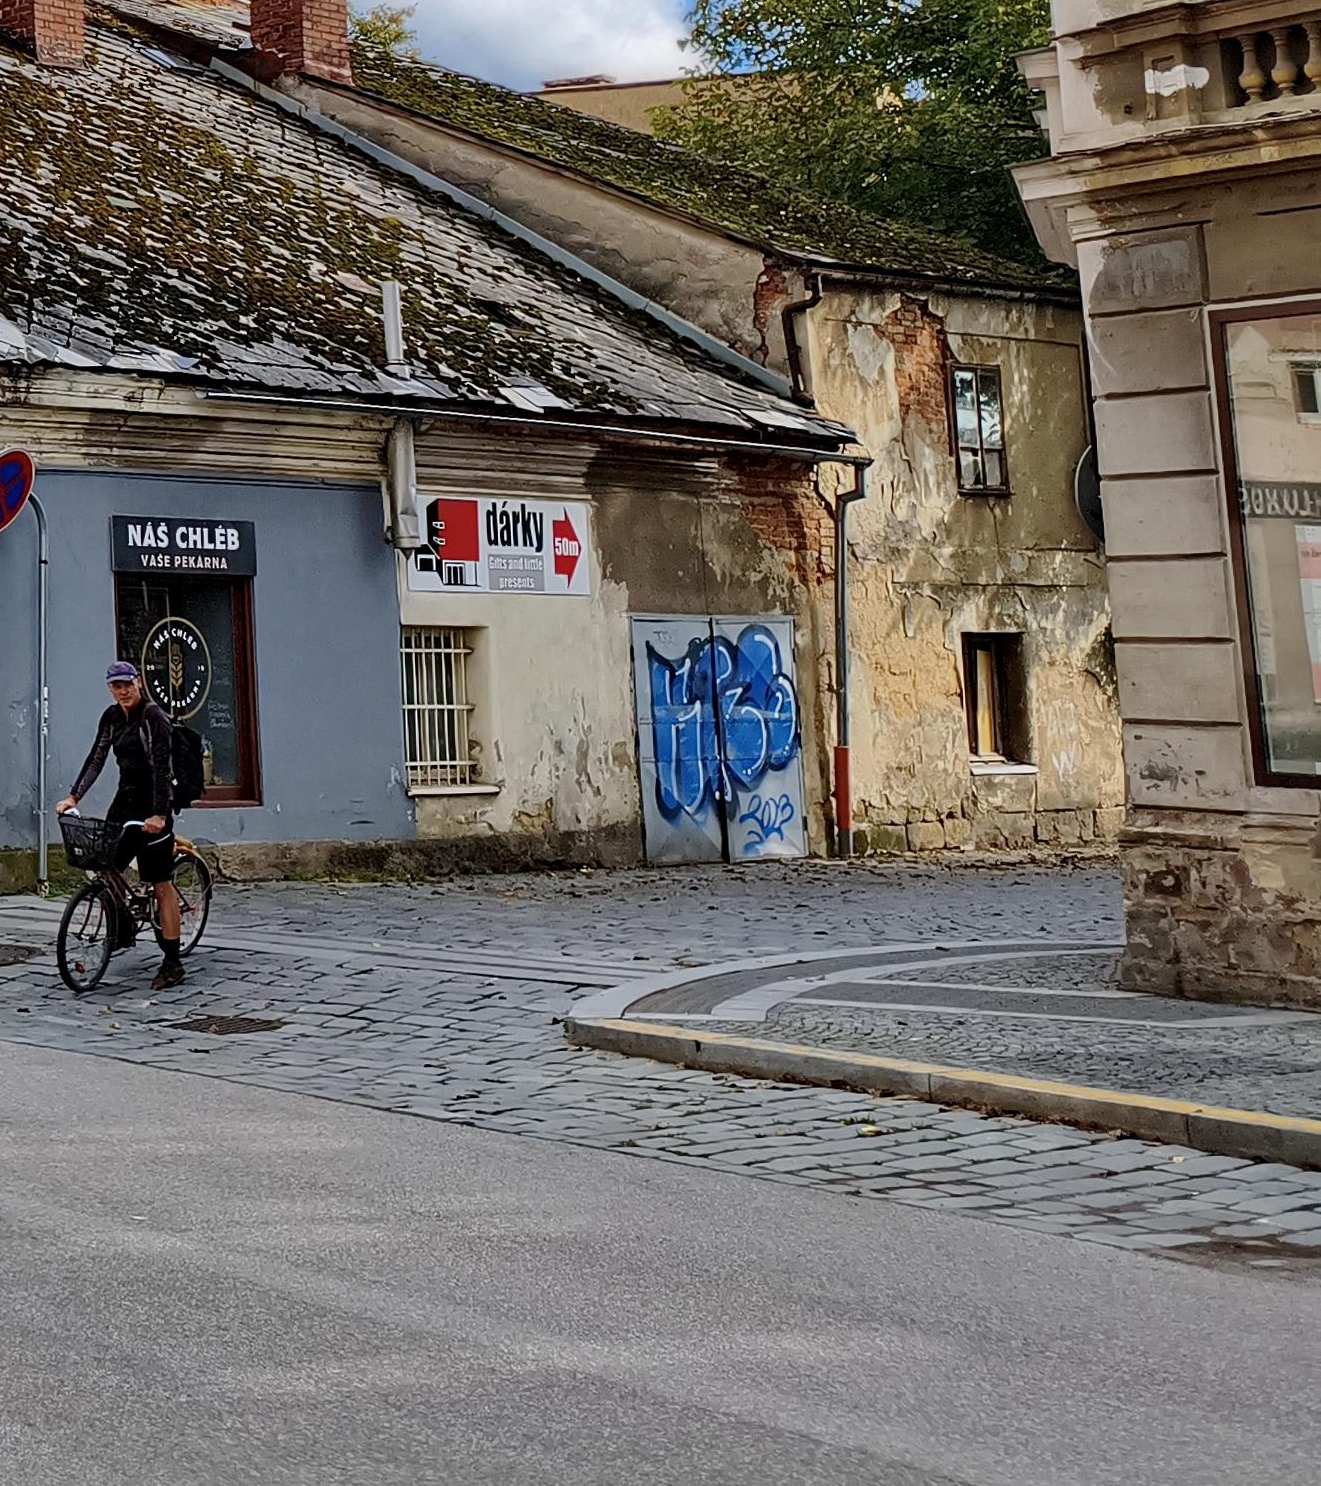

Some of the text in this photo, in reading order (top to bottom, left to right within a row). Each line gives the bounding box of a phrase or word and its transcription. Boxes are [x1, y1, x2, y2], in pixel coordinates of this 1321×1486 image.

[127, 521, 240, 551] NÁŠ CHLÉB
[486, 501, 544, 553] dárky
[554, 537, 579, 557] 50m
[141, 554, 228, 569] VAŠE PEKÁRNA
[489, 556, 544, 572] Gifts and little
[499, 575, 535, 590] presents
